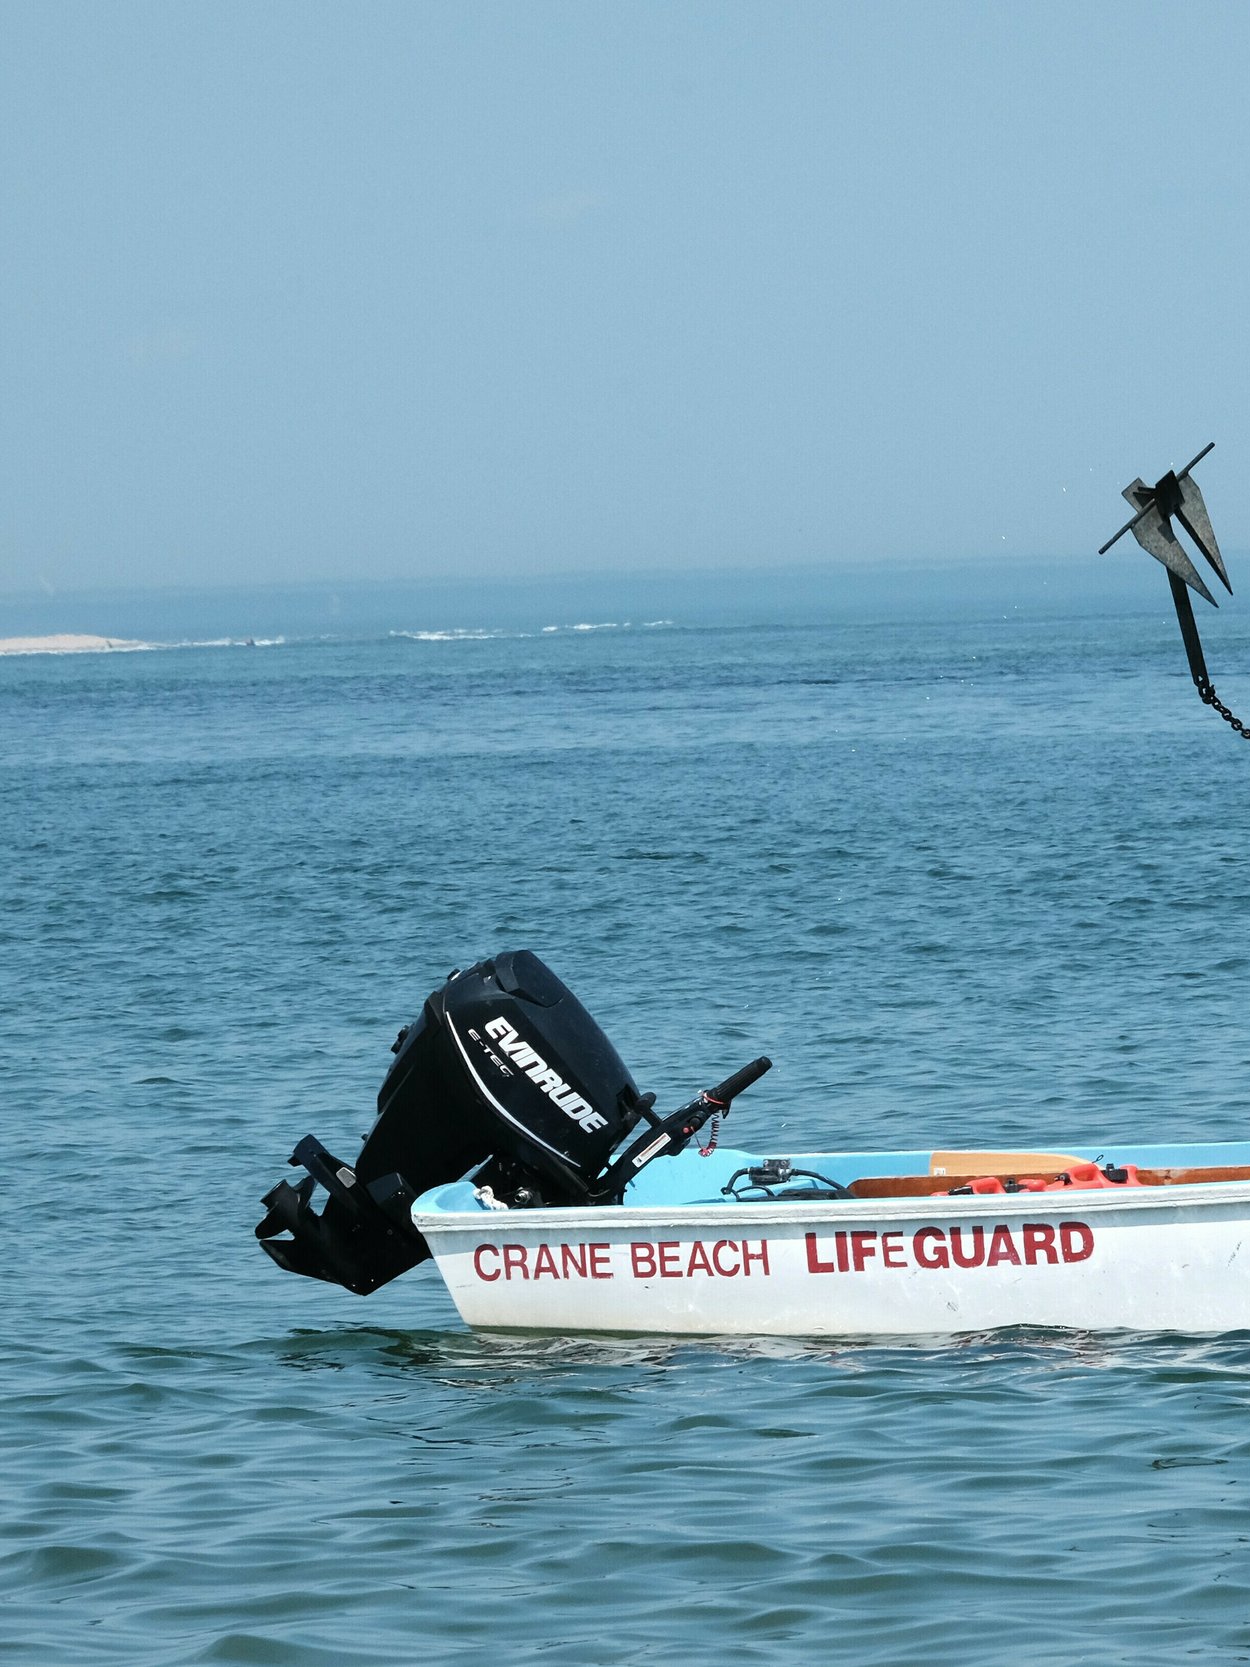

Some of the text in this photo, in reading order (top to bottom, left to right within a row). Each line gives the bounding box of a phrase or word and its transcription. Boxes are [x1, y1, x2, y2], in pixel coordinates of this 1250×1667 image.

[467, 1028, 515, 1078] E-TEC
[485, 1016, 608, 1133] EVINRUDE
[473, 1243, 613, 1282] CRANE
[630, 1239, 770, 1279] BEACH
